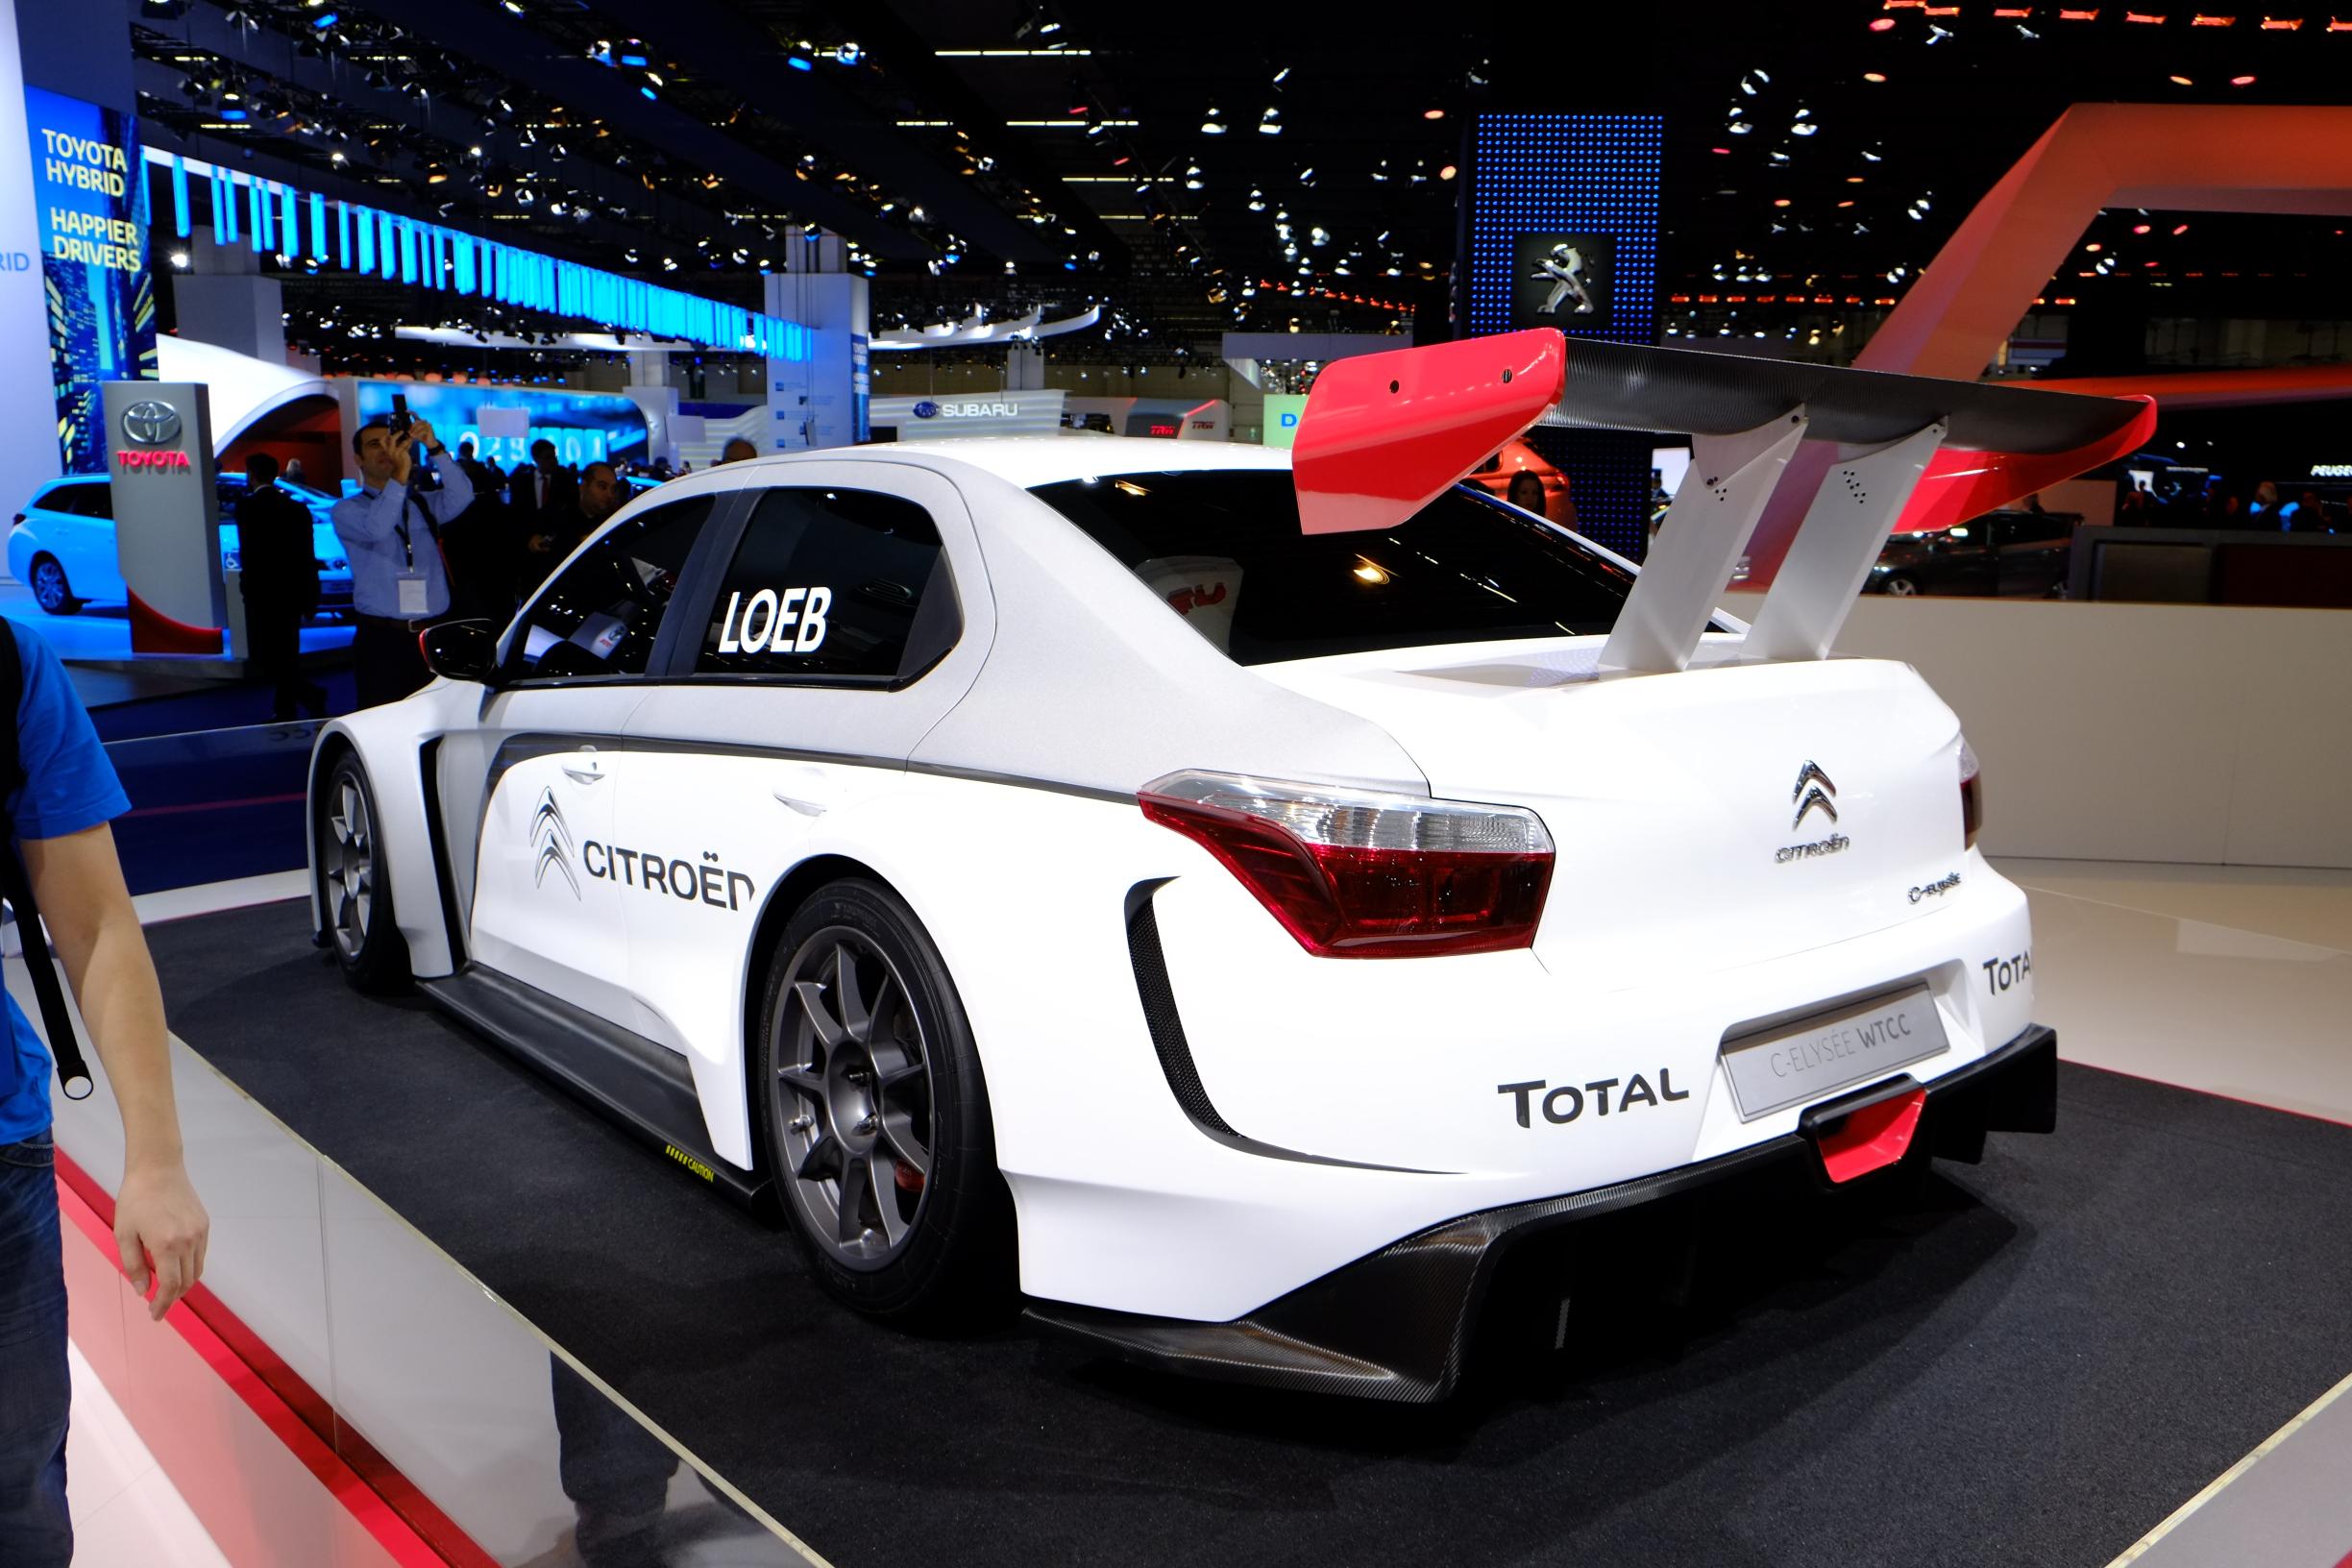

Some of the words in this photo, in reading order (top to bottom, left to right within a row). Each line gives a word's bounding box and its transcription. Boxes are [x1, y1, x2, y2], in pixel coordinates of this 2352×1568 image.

[41, 128, 128, 173] TOYOTA
[45, 158, 125, 198] HYBRID
[50, 207, 138, 244] HAPPIER
[53, 235, 142, 273] DRIVERS
[942, 403, 1018, 417] SUBARU
[117, 450, 190, 468] TOYOTA
[718, 586, 832, 653] LOEB
[1982, 950, 2032, 995] TOTA
[1771, 1028, 1855, 1077] C-ELYSÉE
[1856, 1013, 1911, 1048] WTCC
[1497, 1067, 1689, 1128] TOTAL
